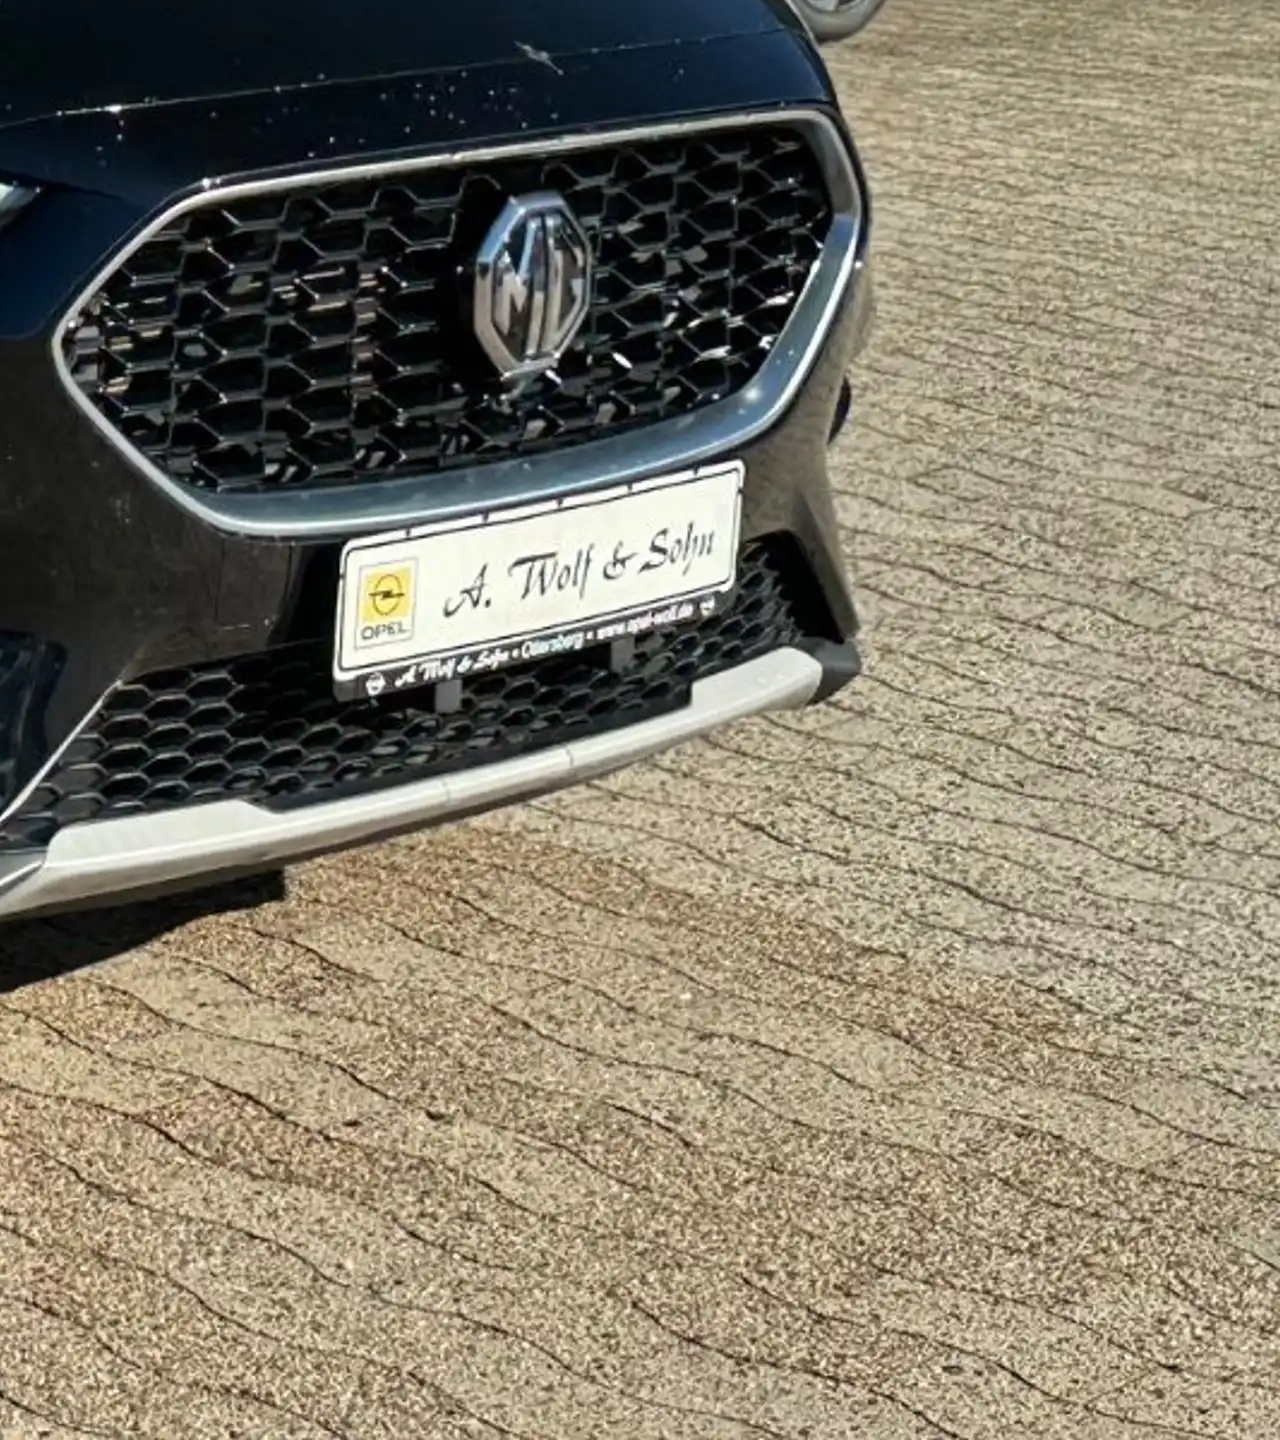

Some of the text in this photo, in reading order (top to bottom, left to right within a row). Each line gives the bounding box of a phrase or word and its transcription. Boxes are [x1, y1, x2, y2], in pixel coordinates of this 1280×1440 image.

[603, 540, 639, 579] &
[638, 521, 715, 576] Sohn
[360, 622, 408, 640] OPEL
